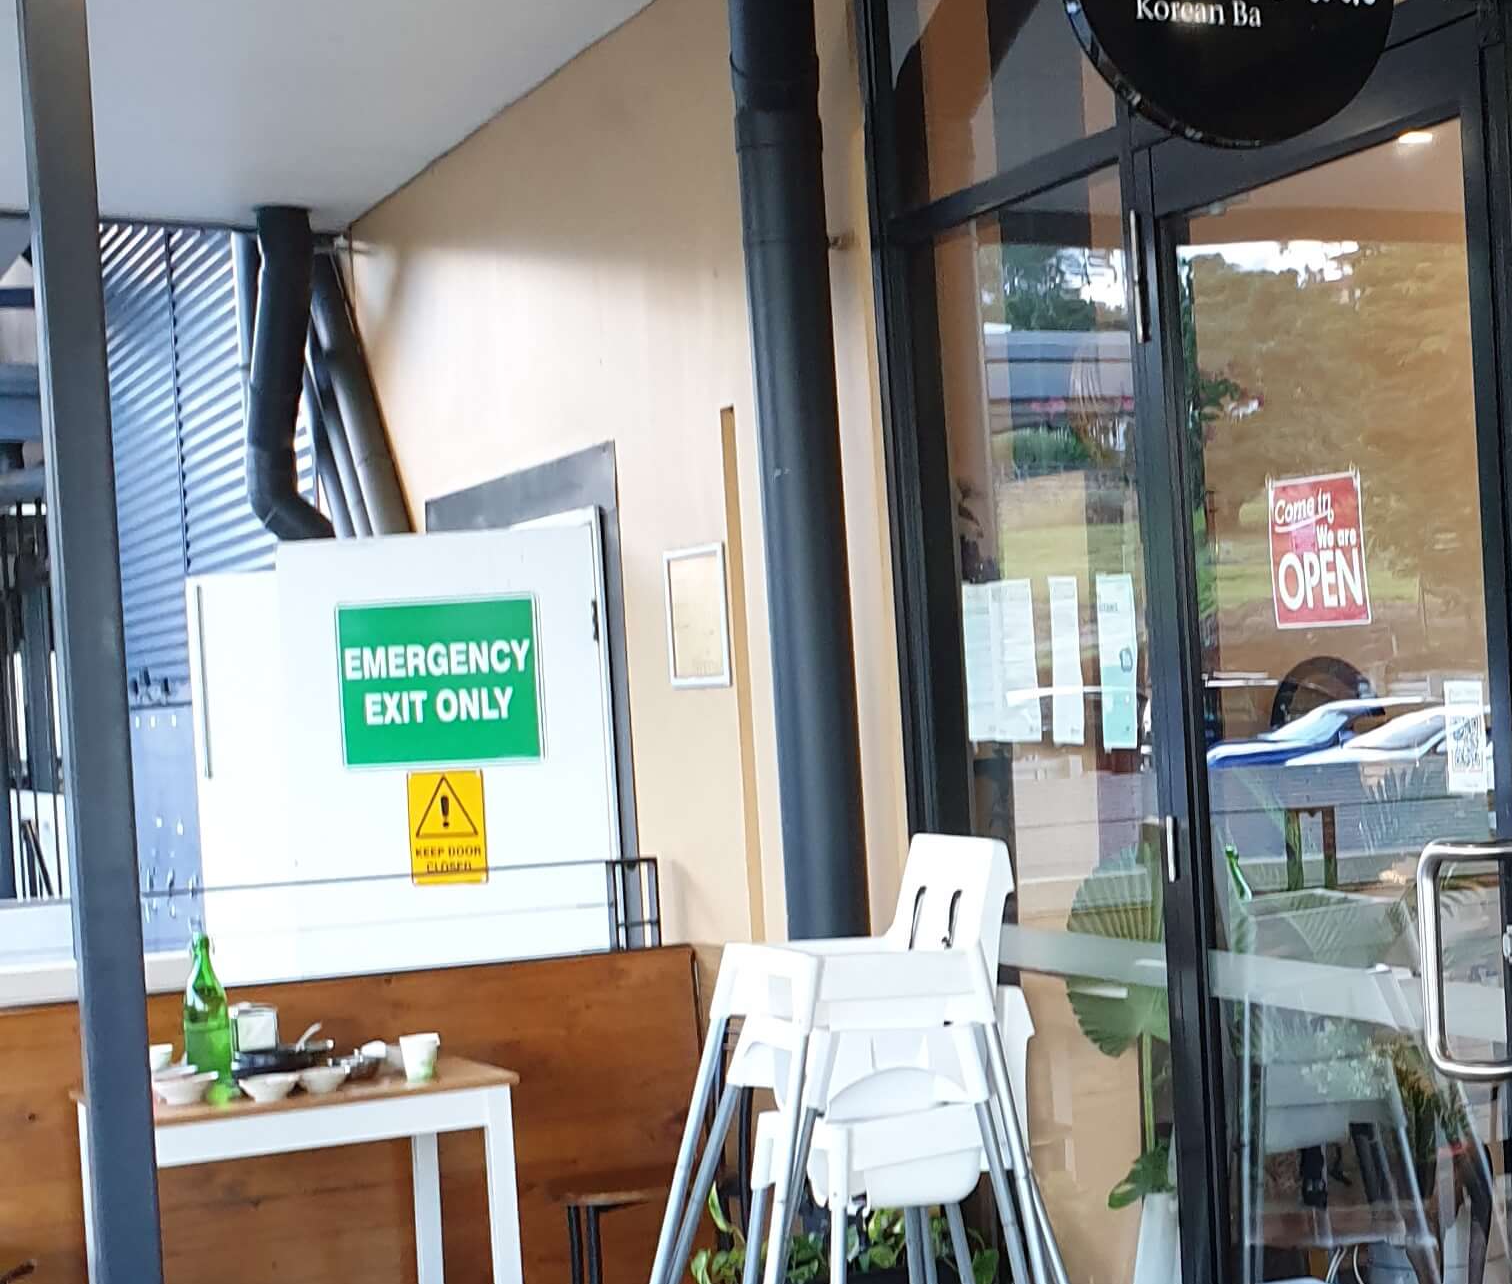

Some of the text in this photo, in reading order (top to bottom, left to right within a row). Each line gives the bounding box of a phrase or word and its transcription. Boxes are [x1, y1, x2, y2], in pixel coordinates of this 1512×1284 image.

[1274, 497, 1314, 525] Come
[1316, 524, 1357, 548] We are
[1278, 547, 1364, 611] OPEN
[344, 639, 531, 680] EMERGENCY
[364, 686, 514, 725] EXIT ONLY
[415, 844, 482, 858] KEEP DOOR
[426, 860, 472, 875] CLOSED
